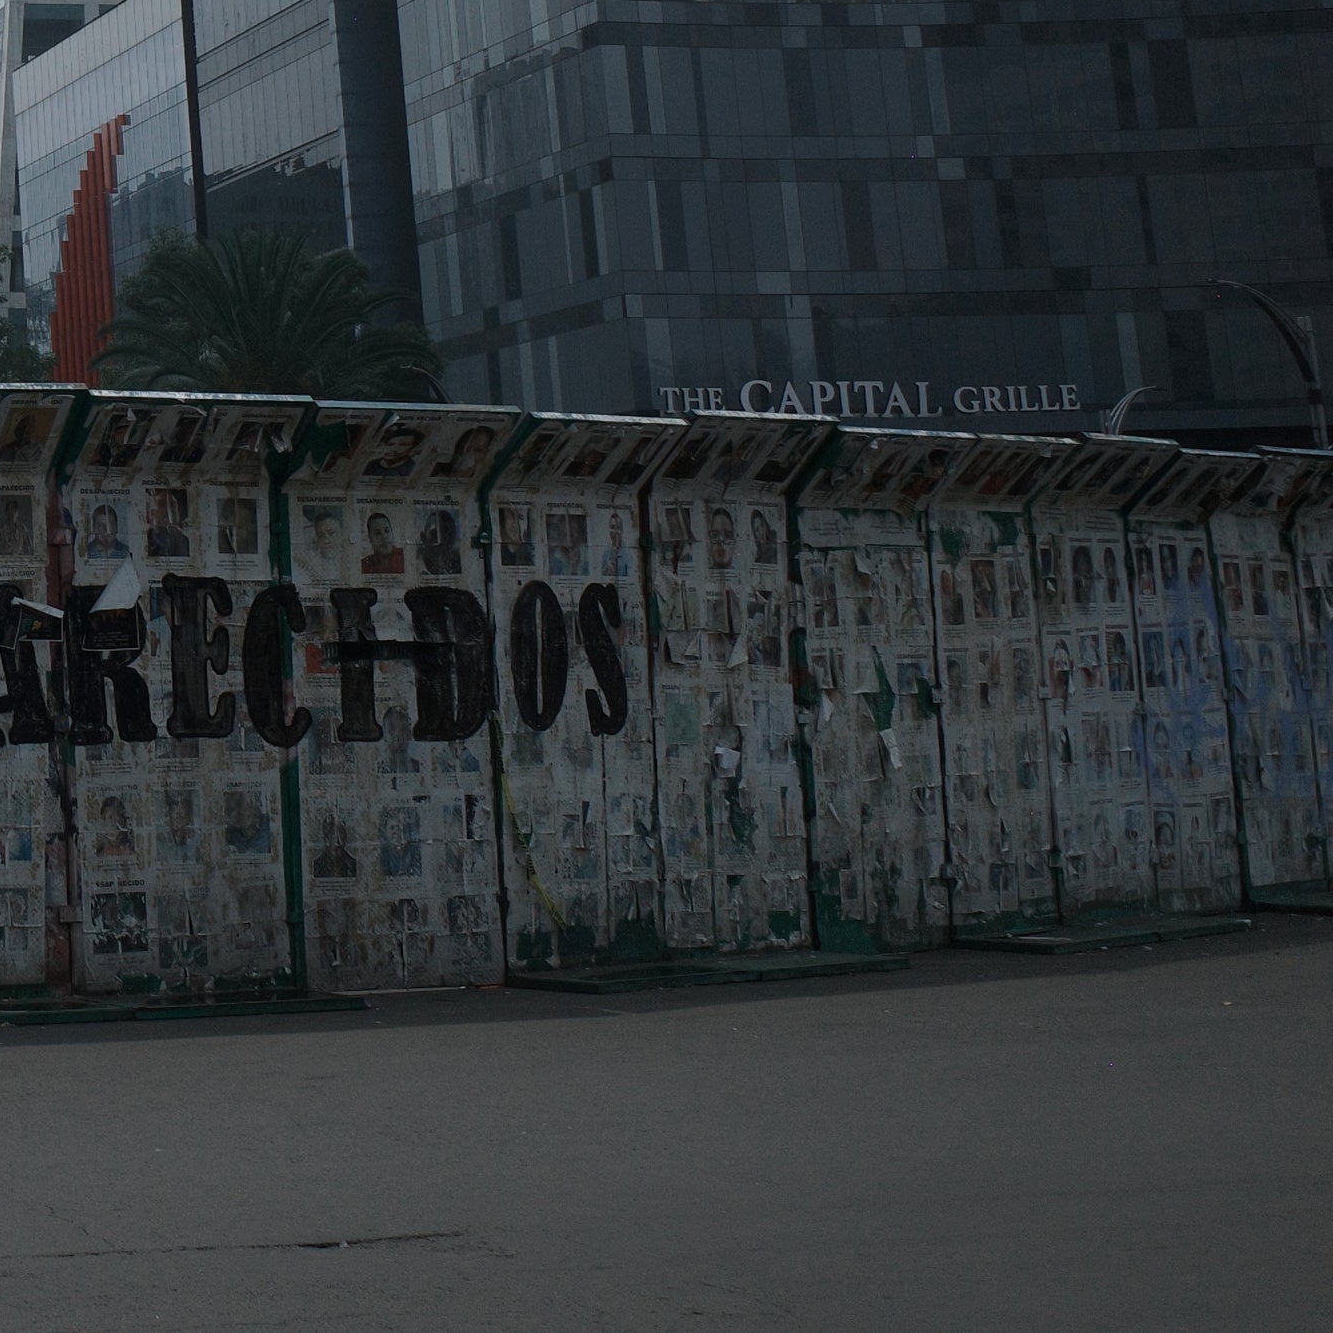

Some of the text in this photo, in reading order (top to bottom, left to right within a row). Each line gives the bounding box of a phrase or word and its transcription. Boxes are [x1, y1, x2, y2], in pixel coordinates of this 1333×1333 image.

[660, 379, 1082, 418] THE CAPITAL GRILLE
